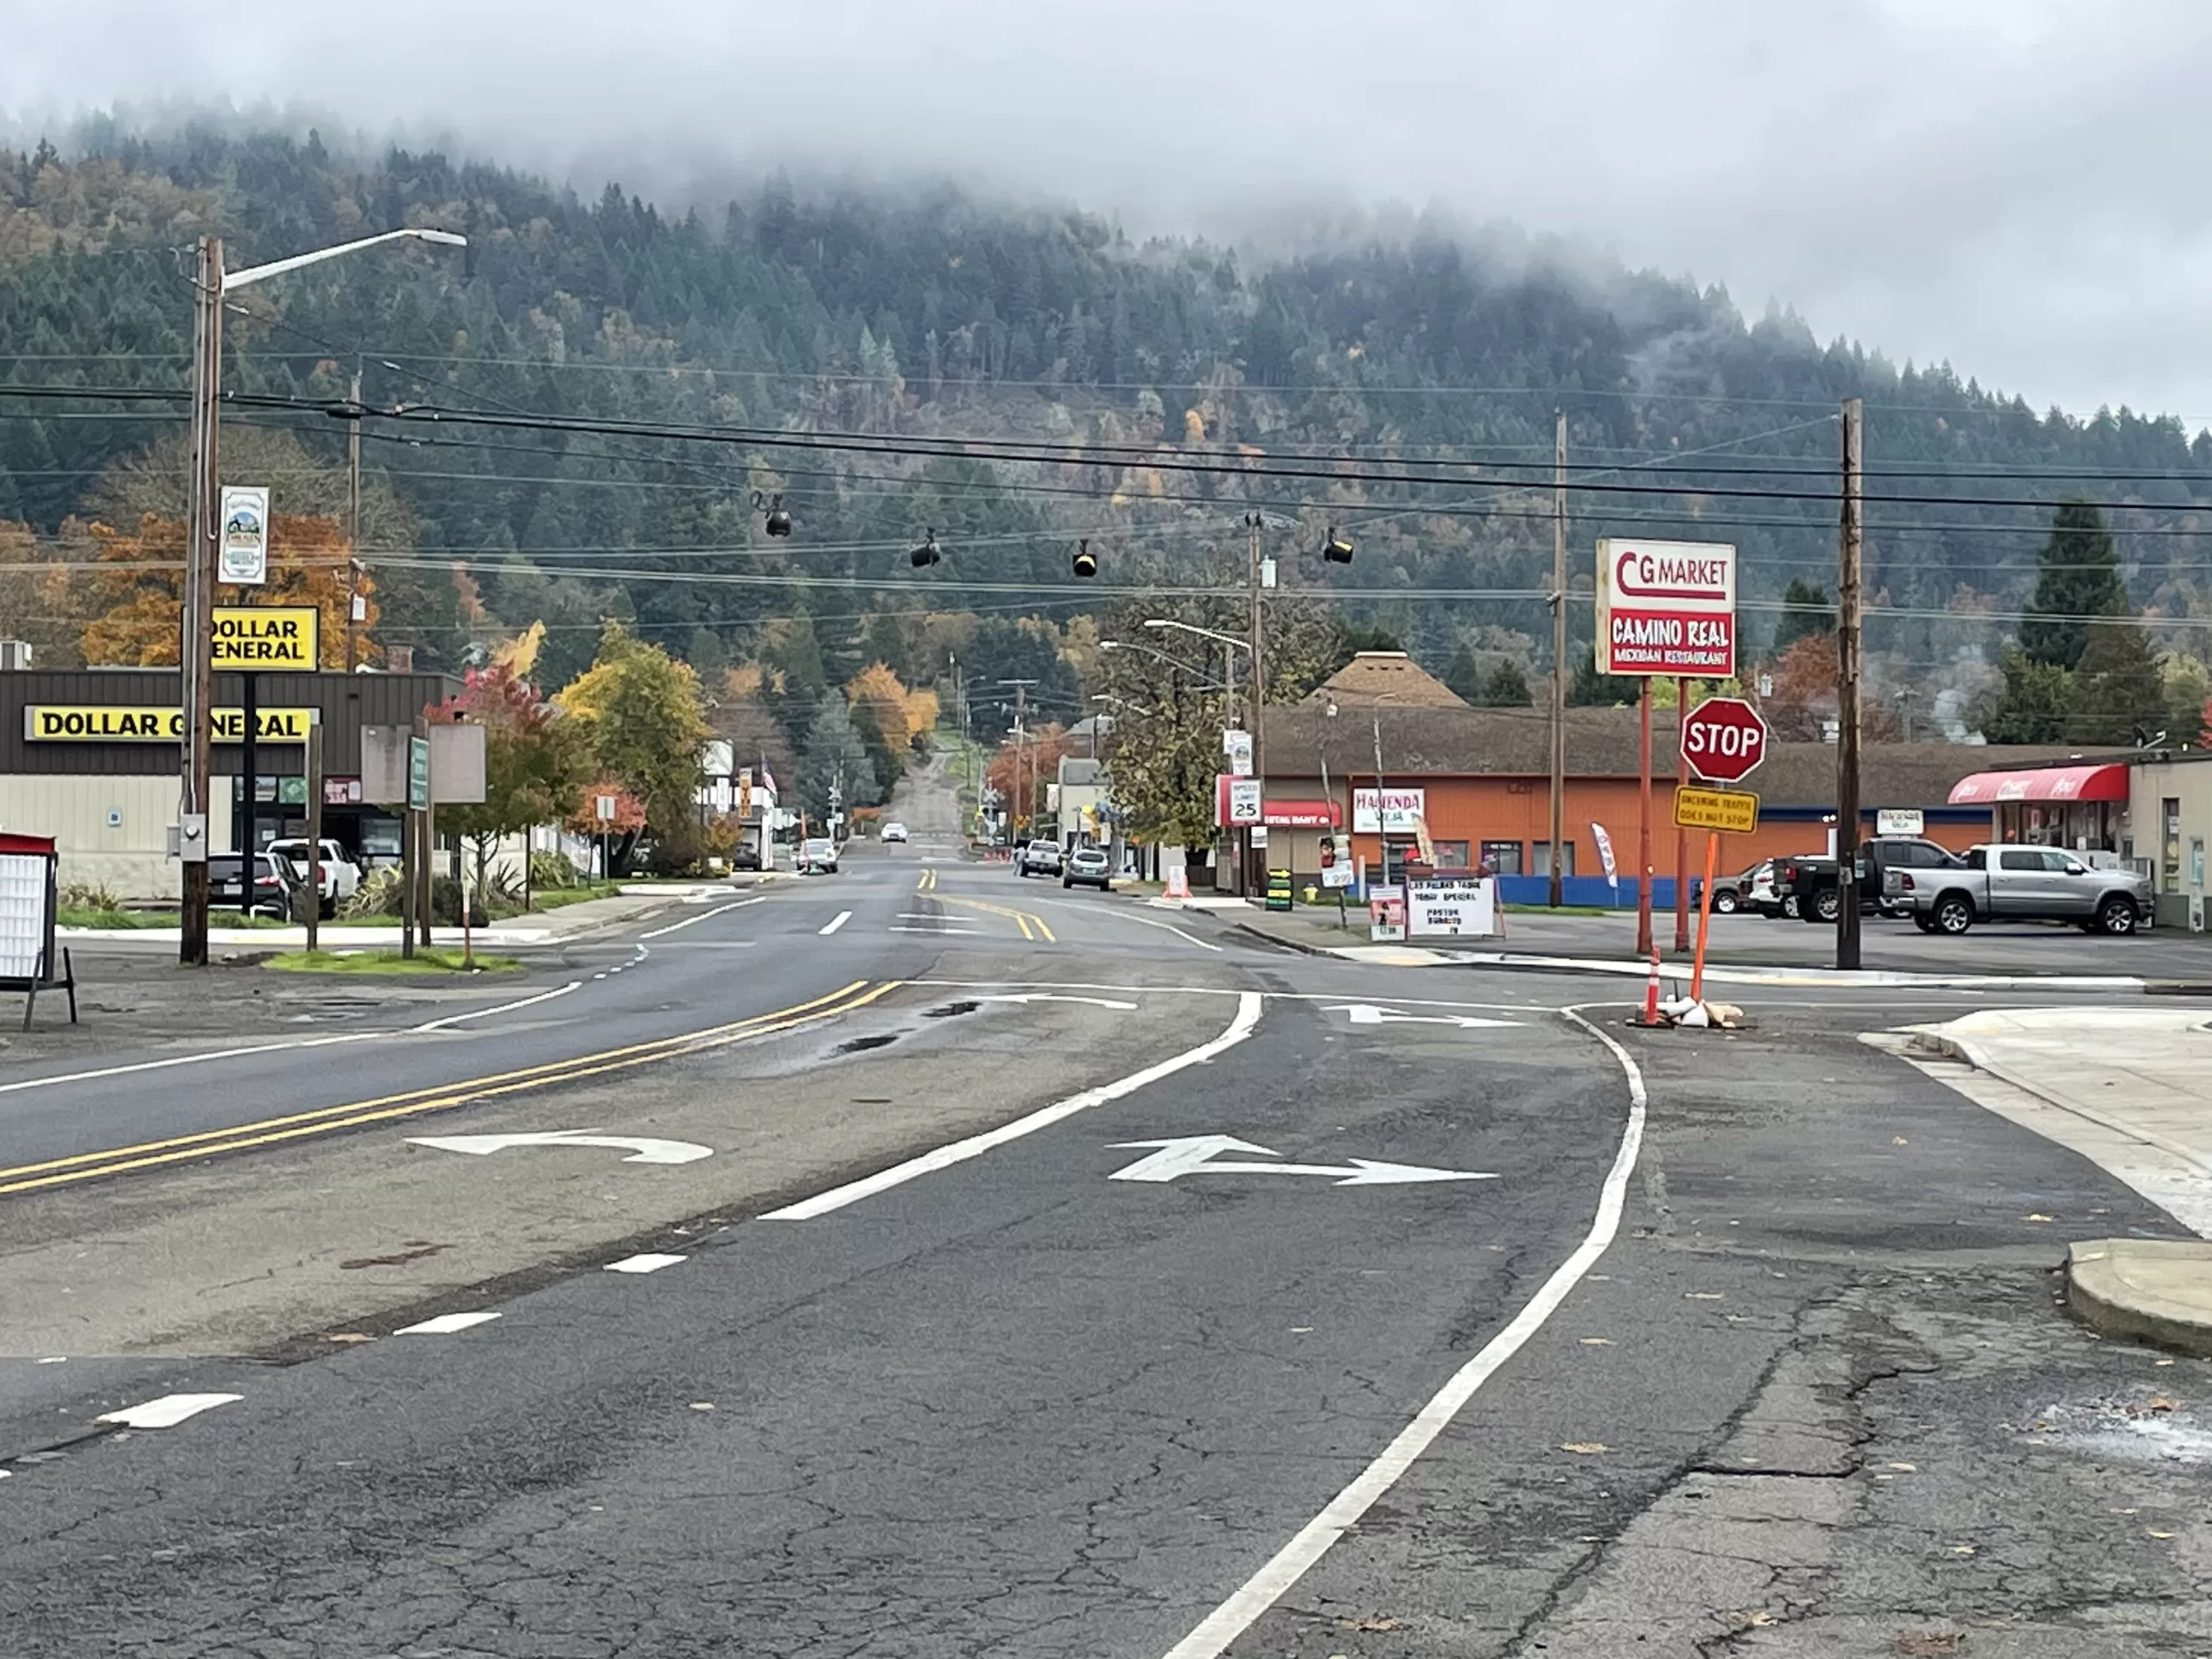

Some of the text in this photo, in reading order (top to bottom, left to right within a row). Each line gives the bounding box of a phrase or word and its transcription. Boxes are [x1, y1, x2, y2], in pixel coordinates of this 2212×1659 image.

[1658, 558, 1727, 585] MARKET
[1612, 617, 1729, 647] CAMINO REAL
[1663, 651, 1727, 665] RESTAURANT
[42, 713, 160, 734] DOLLAR
[1688, 721, 1760, 757] STOP
[1235, 804, 1256, 817] 25
